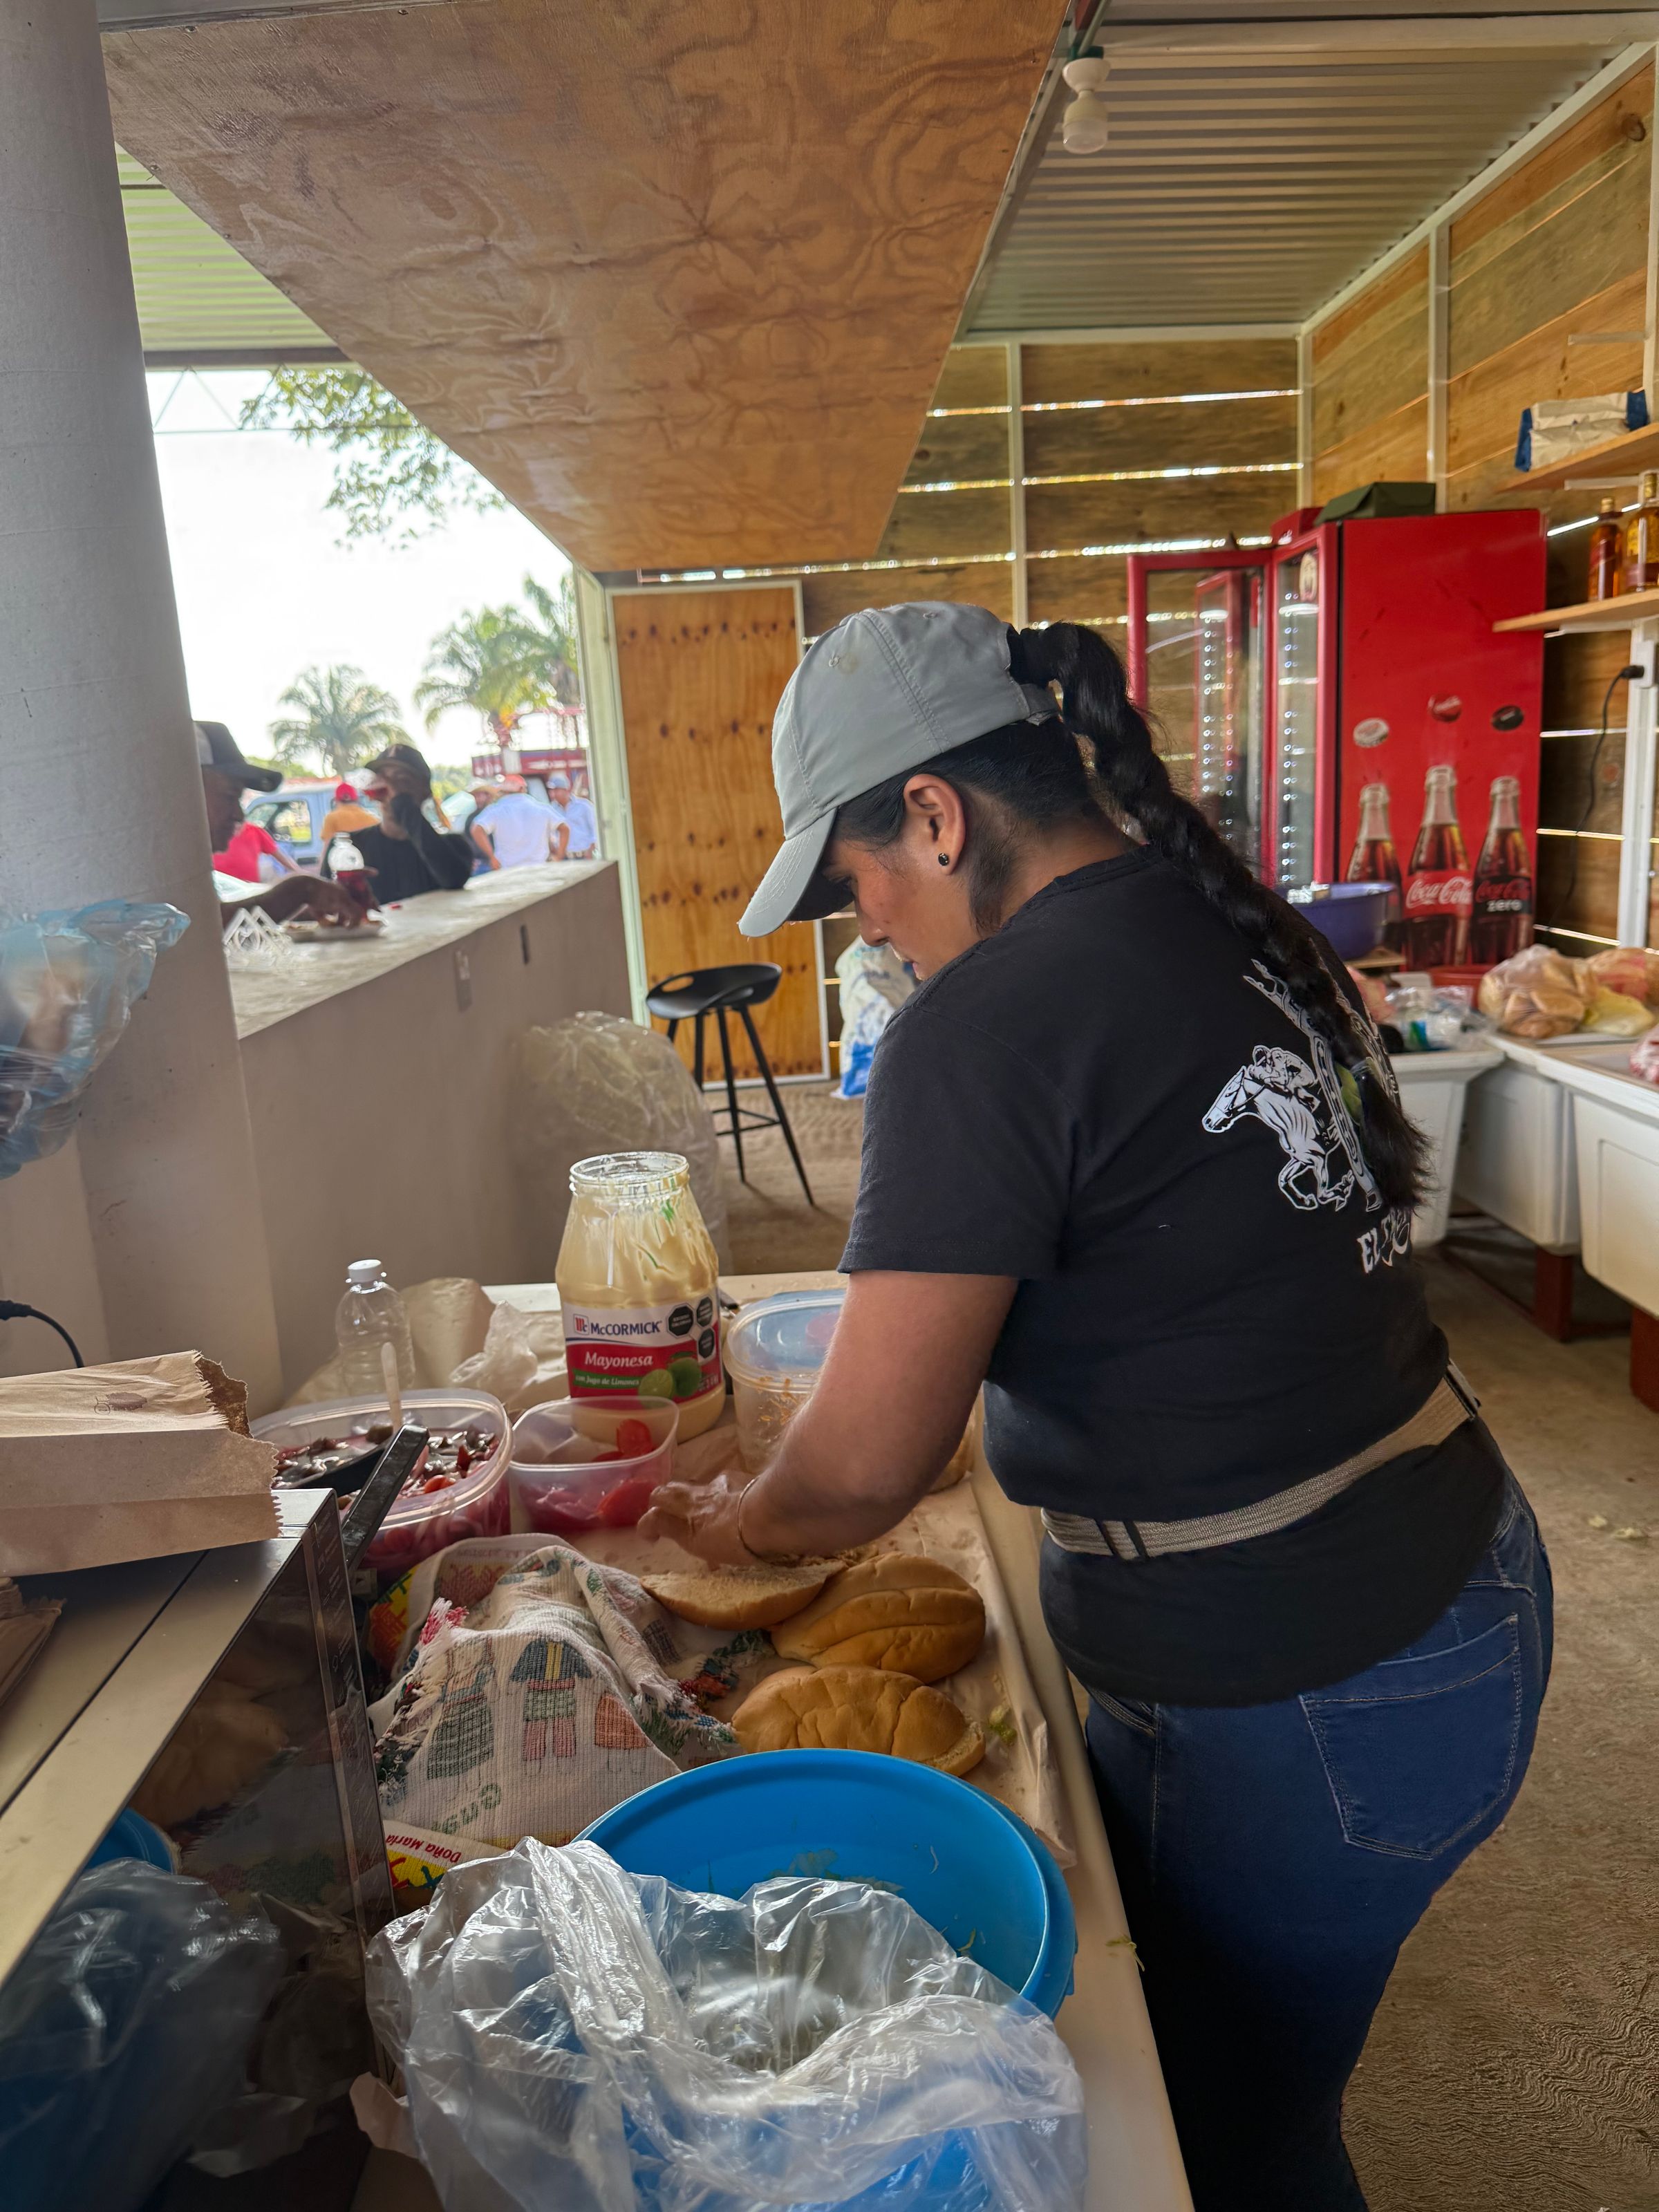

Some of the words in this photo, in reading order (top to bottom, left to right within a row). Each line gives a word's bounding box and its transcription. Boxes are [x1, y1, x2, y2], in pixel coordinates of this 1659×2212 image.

[590, 1321, 662, 1335] McCORMICK
[585, 1351, 653, 1369] Mayonesa
[425, 1844, 462, 1864] Doña
